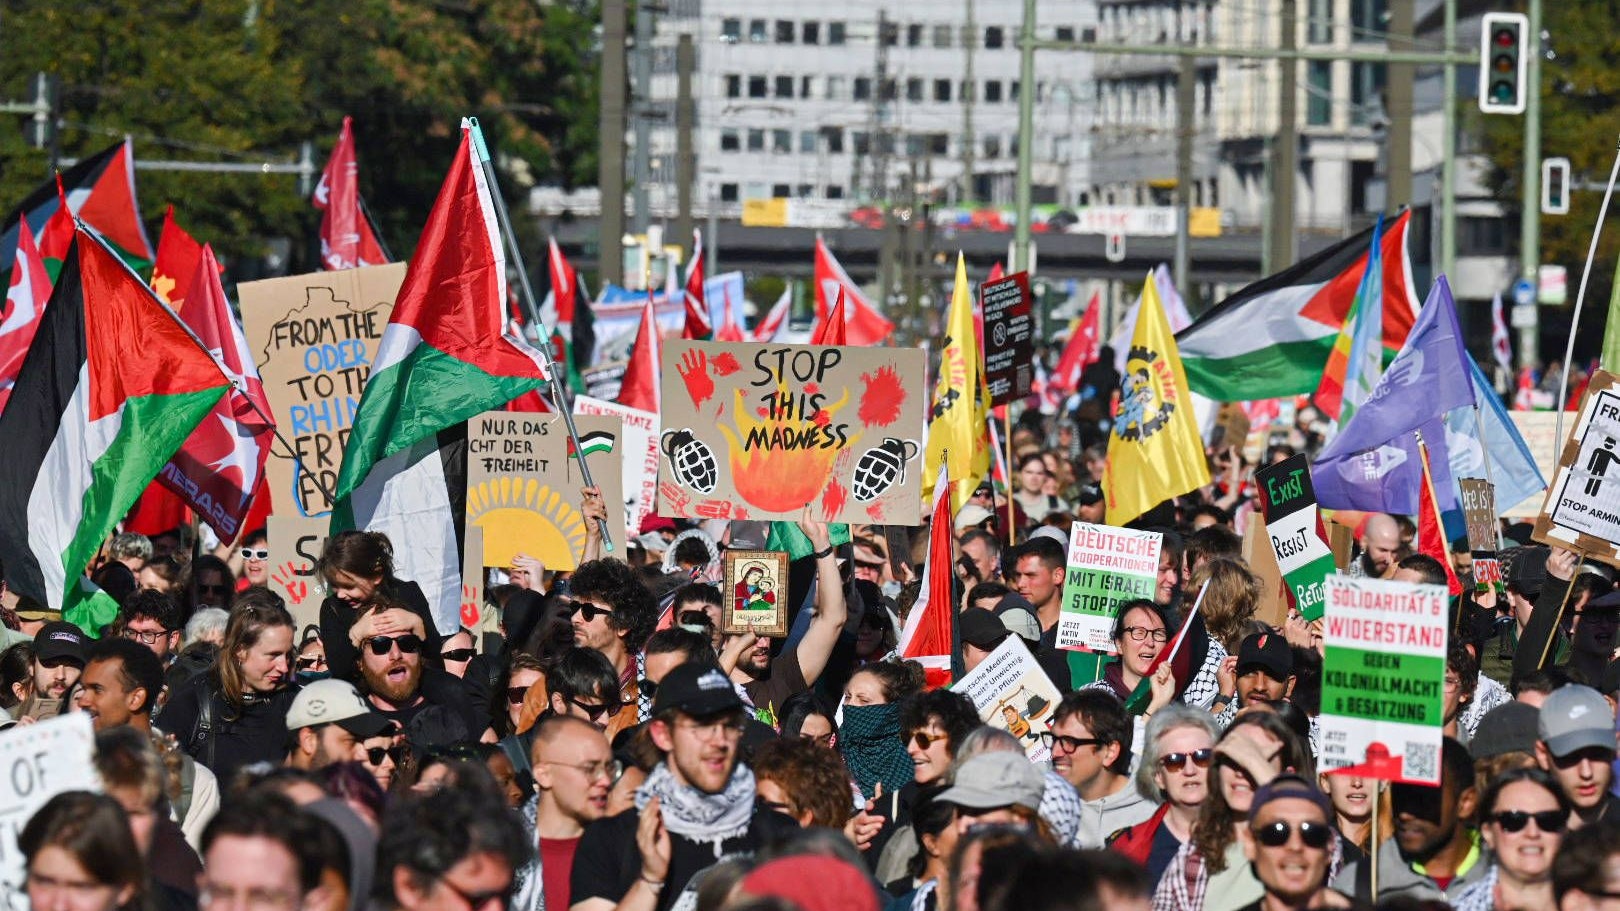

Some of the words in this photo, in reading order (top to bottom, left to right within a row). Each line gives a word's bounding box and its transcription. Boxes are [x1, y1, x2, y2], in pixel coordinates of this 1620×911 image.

[274, 317, 336, 349] FROM
[336, 312, 381, 338] THE
[304, 339, 369, 373] ODER
[751, 348, 841, 386] STOP
[287, 374, 333, 400] TO
[338, 366, 372, 394] TH
[761, 392, 826, 421] THIS
[1600, 403, 1620, 422] FR
[482, 419, 517, 435] NUR
[523, 422, 548, 435] DAS
[745, 424, 848, 452] MADNESS
[469, 439, 496, 453] CHT
[504, 440, 533, 454] DER
[481, 458, 549, 472] FREIHEIT
[1562, 498, 1588, 514] STOP
[1075, 530, 1157, 557] DEUTSCHE
[296, 536, 329, 576] S
[1072, 552, 1155, 572] KOOPERATIONEN
[1069, 571, 1095, 588] MIT
[1101, 574, 1150, 596] ISRAEL
[1072, 594, 1118, 612] STOPP
[1332, 588, 1424, 615] SOLIDARITÄT
[1061, 630, 1079, 638] AKTIV
[1062, 621, 1080, 629] JETZT
[1328, 616, 1444, 648] WIDERSTAND
[1060, 638, 1084, 647] WERDEN
[1364, 652, 1401, 669] GEGEN
[965, 672, 987, 693] utsche
[1325, 670, 1439, 698] KOLONIALMACHT
[977, 689, 998, 710] lance?
[1347, 697, 1426, 721] BESATZUNG
[11, 752, 49, 797] OF
